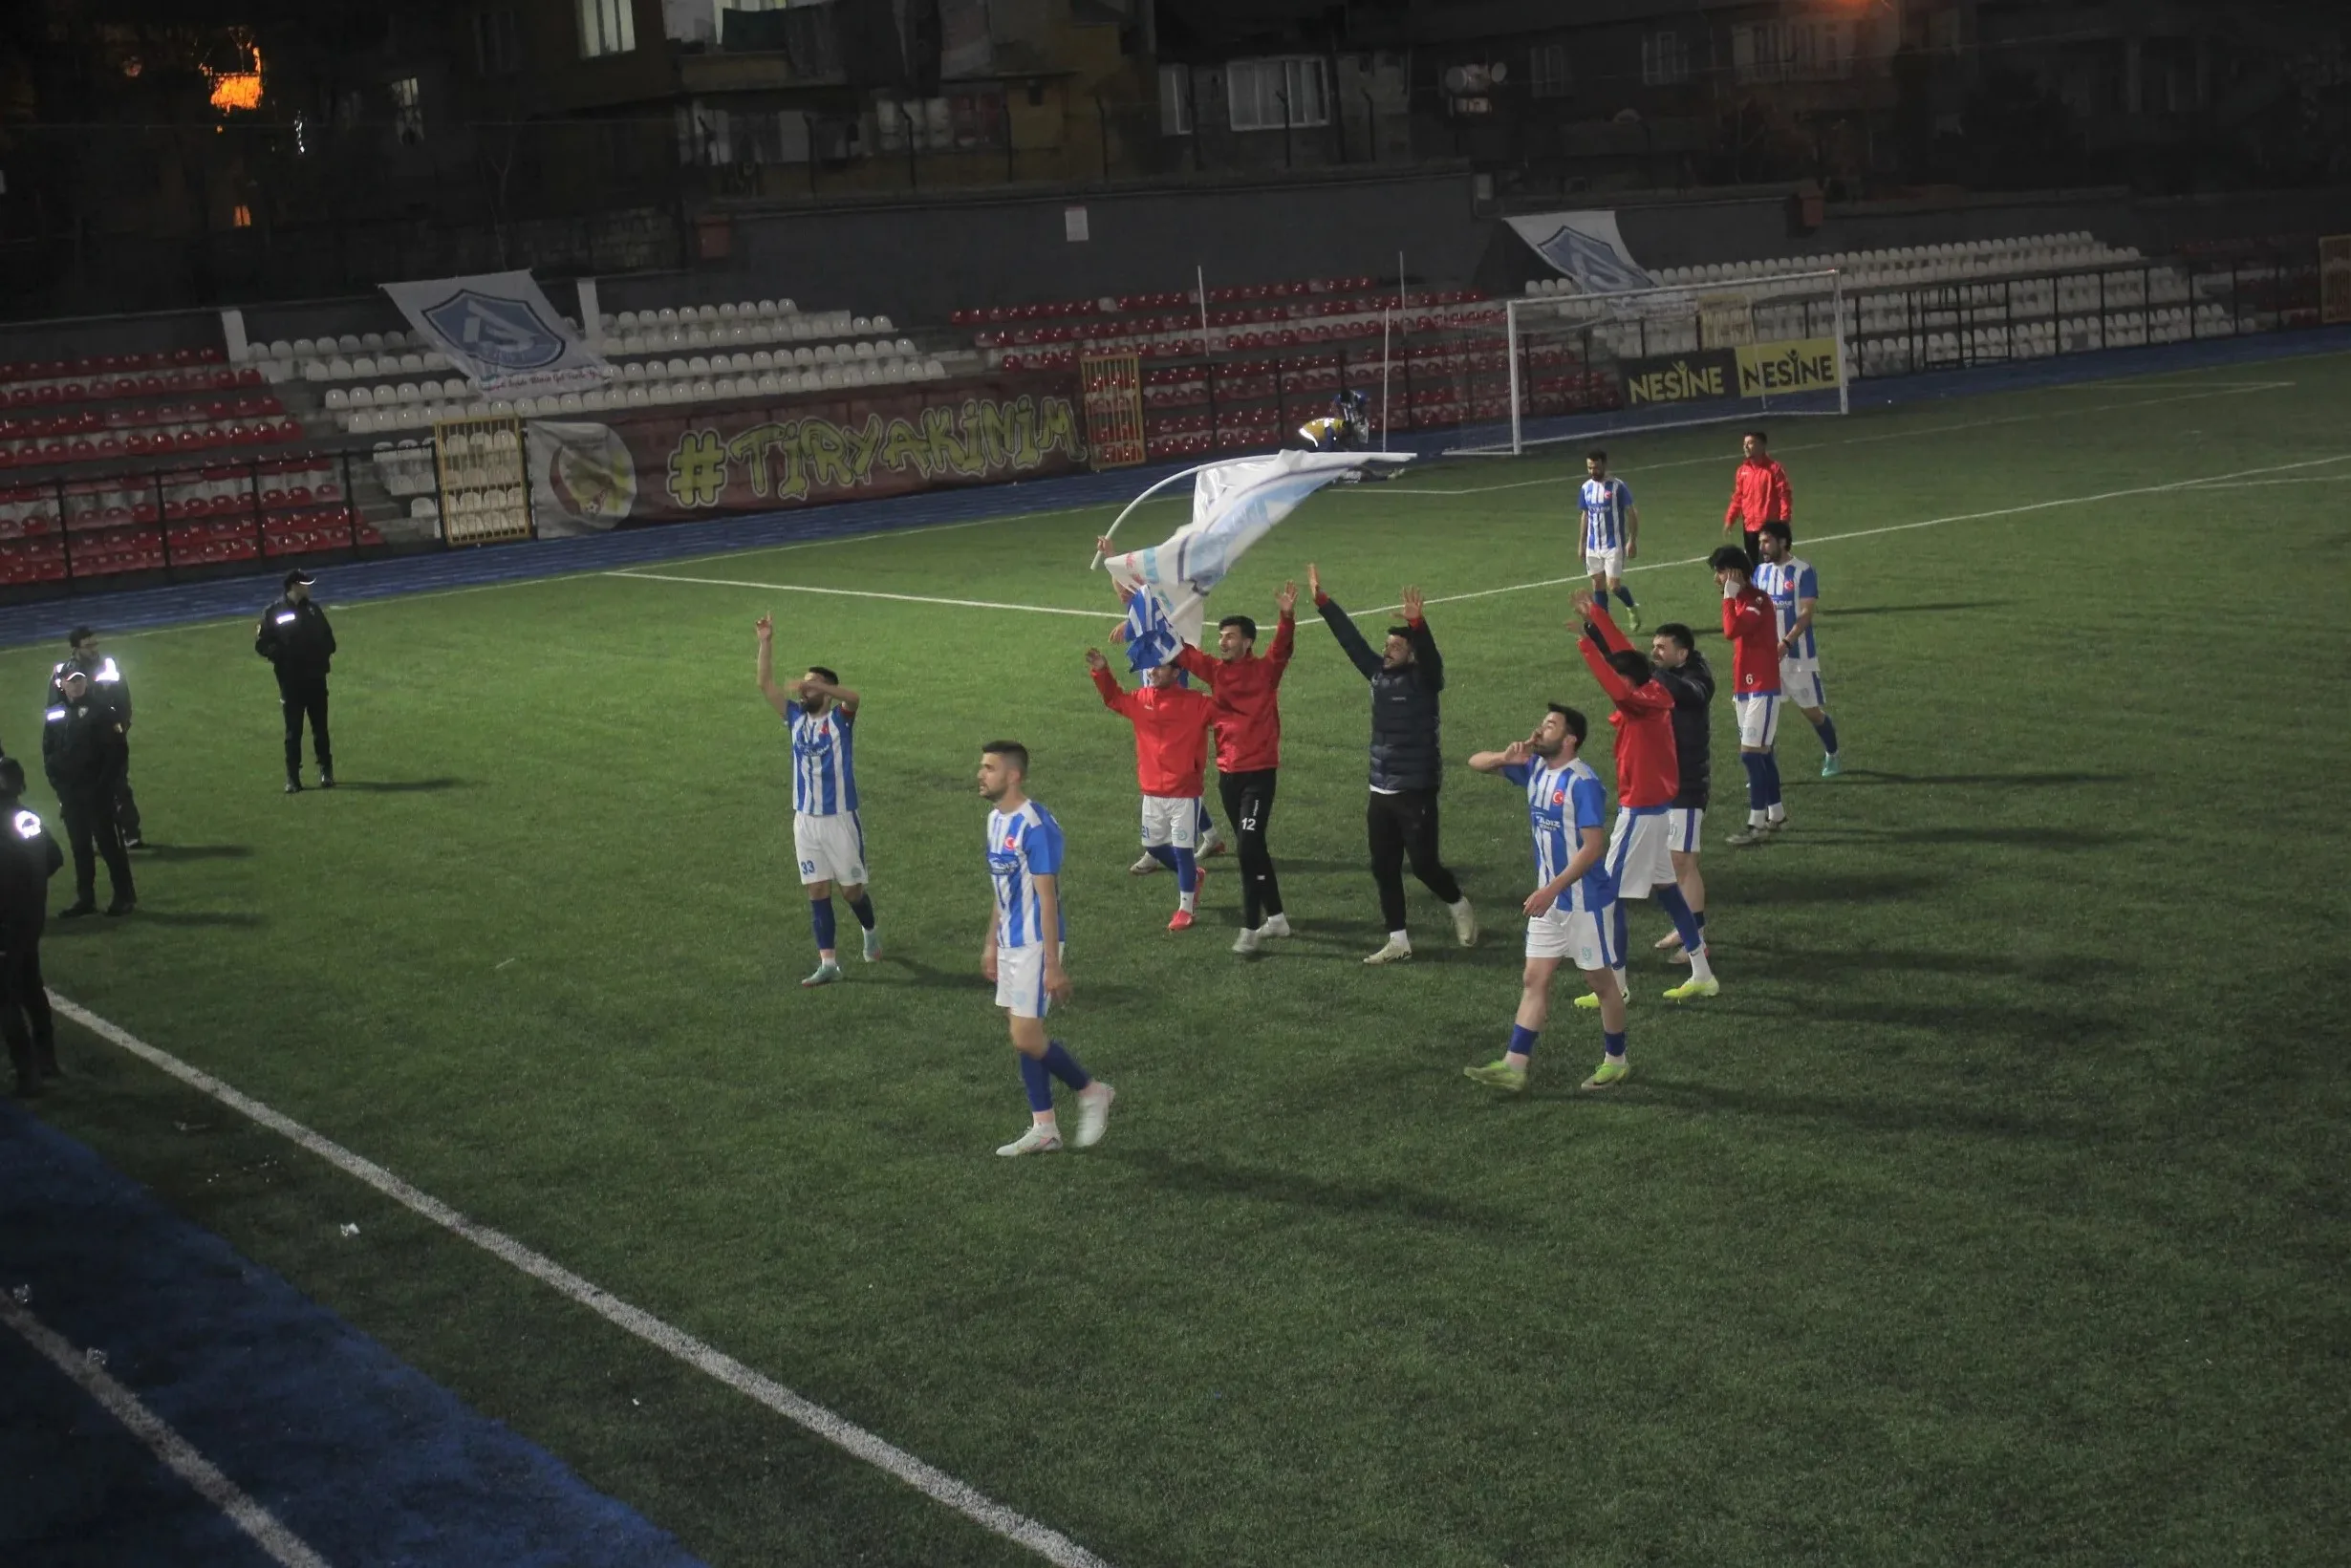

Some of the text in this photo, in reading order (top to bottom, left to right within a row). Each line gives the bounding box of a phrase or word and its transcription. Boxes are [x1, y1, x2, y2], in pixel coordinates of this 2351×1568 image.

[1746, 673, 1754, 685] 6
[1241, 817, 1256, 830] 12
[801, 859, 815, 875] 33
